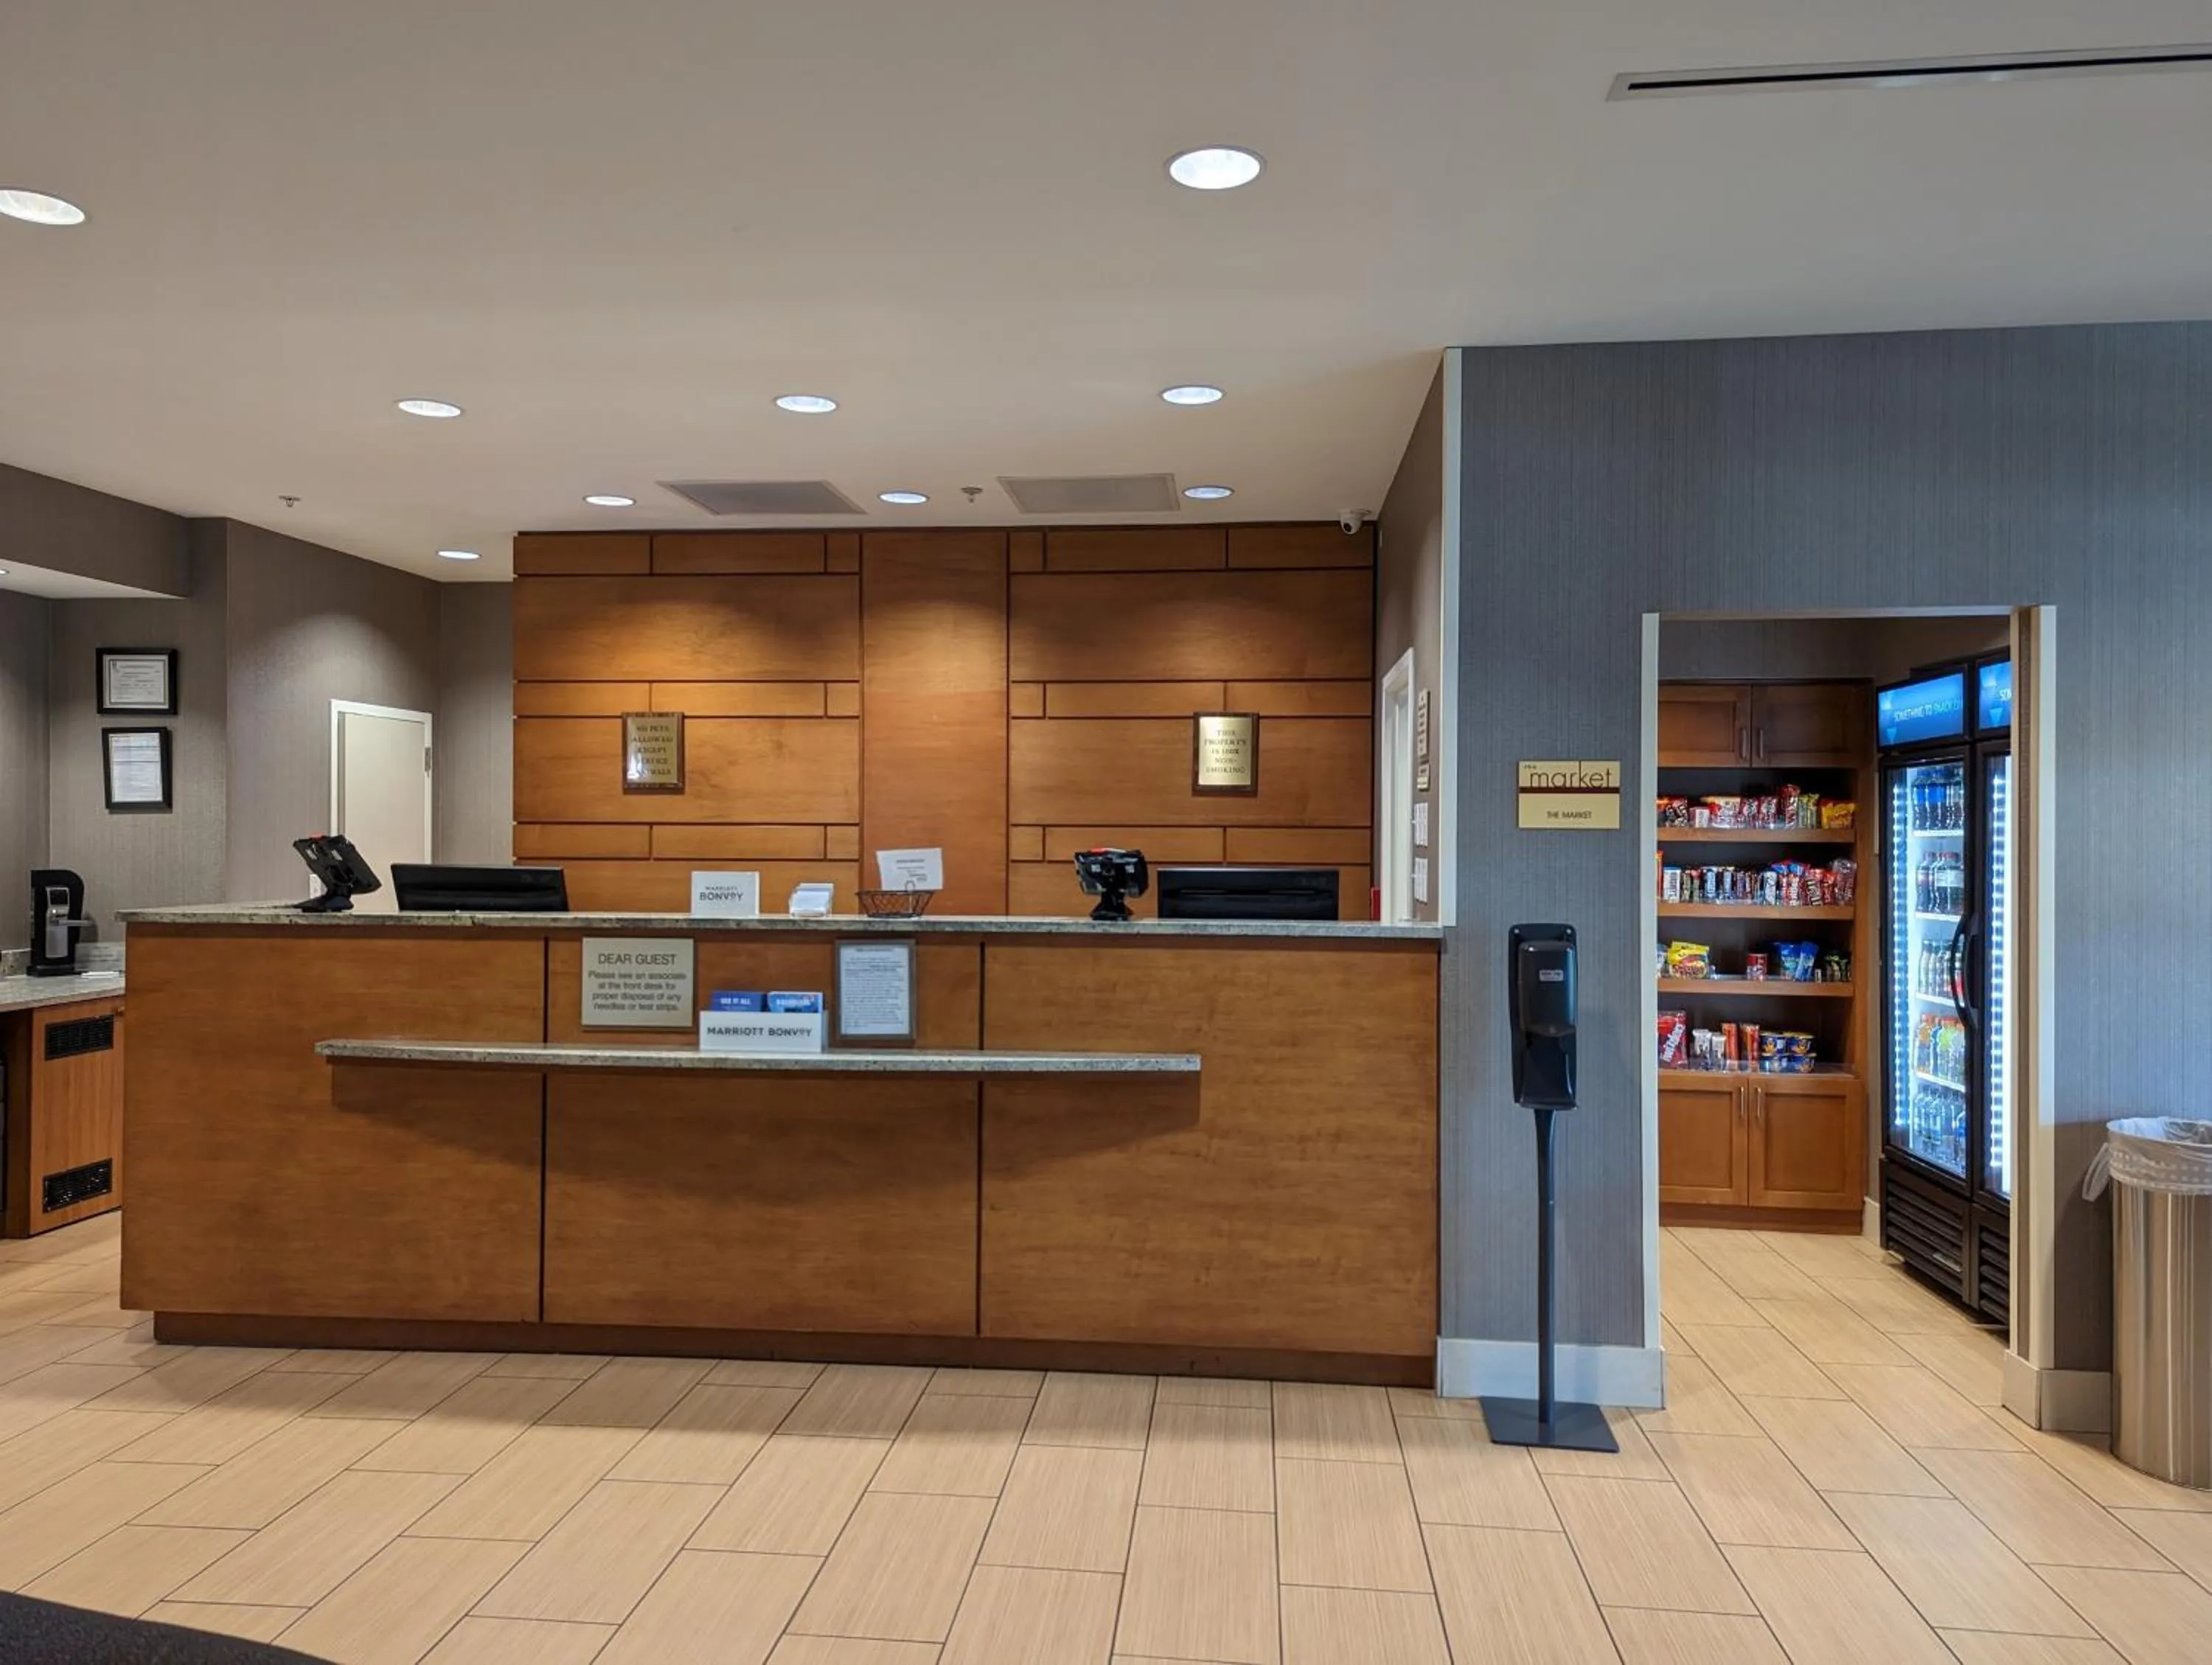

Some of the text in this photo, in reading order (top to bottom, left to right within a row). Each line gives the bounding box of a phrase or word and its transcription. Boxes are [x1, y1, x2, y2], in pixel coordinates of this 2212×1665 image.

[1530, 760, 1612, 788] market
[699, 891, 744, 902] BONVOY
[598, 953, 677, 965] DEAR GUEST
[588, 970, 616, 979] Please
[648, 972, 687, 980] associate
[608, 981, 621, 990] the
[623, 981, 641, 990] front
[644, 981, 663, 990] desk
[592, 993, 619, 1001] proper
[621, 992, 655, 1001] disposal
[667, 993, 682, 1002] any
[707, 1026, 813, 1037] MARRIOTT BONVOY
